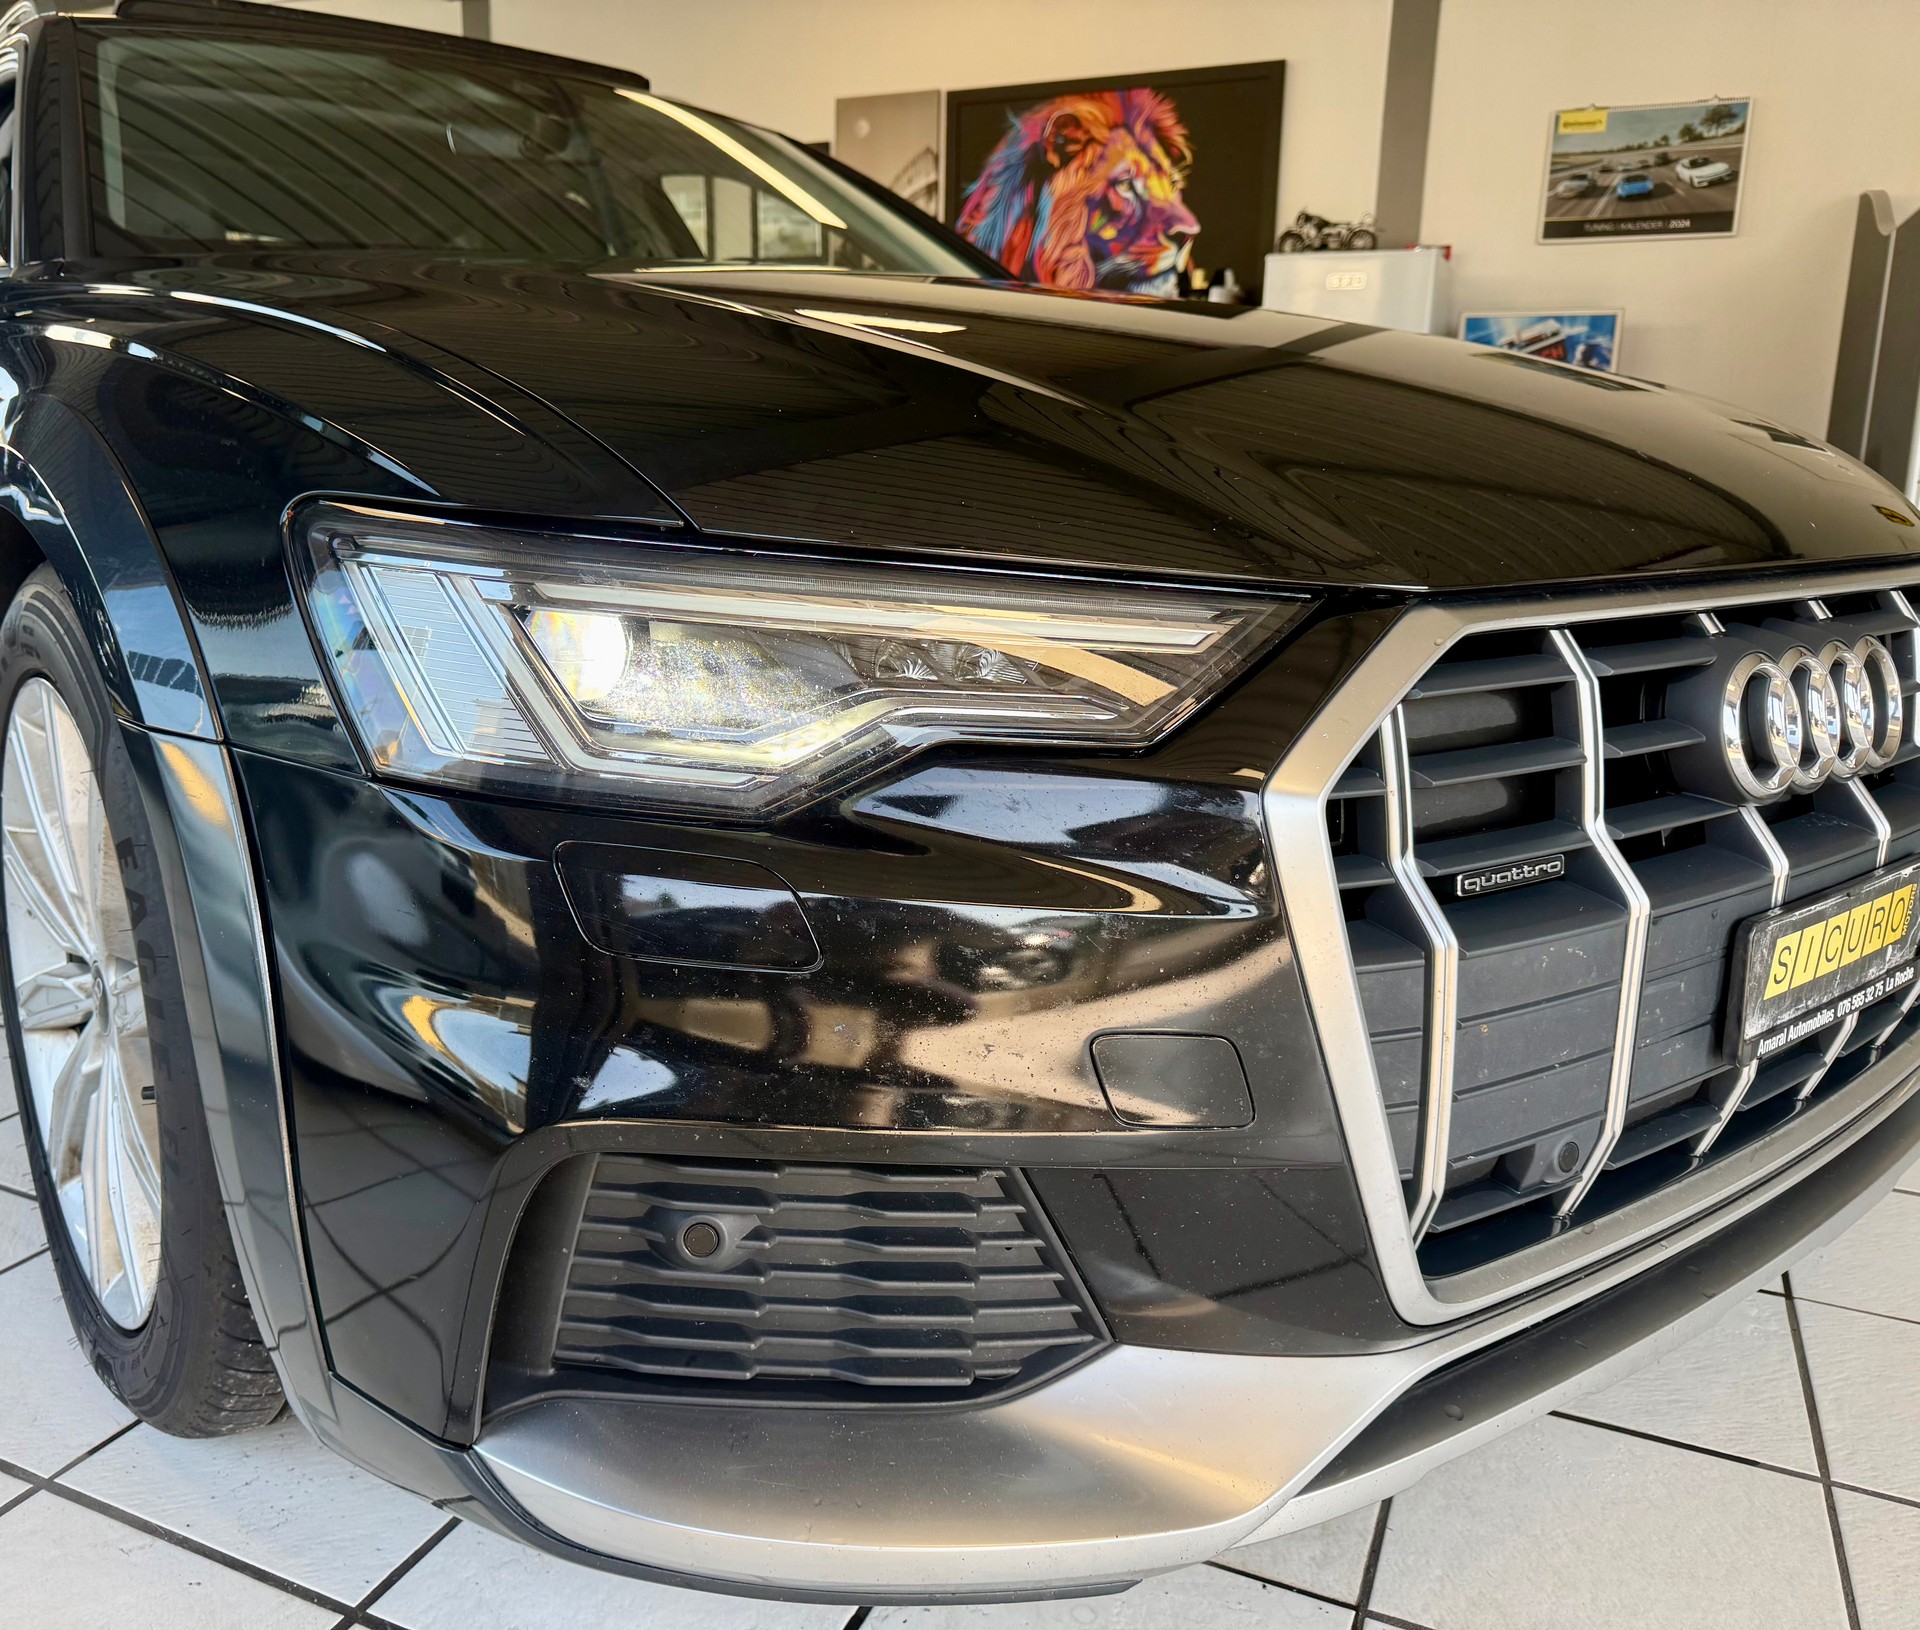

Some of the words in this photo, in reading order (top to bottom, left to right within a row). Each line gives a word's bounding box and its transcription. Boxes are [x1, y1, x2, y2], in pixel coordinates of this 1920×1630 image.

[1464, 861, 1561, 891] quattro
[1773, 897, 1906, 985] SICURO
[1757, 1029, 1787, 1056] Amaral
[1788, 1008, 1835, 1042] Automobiles
[1837, 998, 1851, 1018] 076
[1851, 990, 1865, 1010] 565
[1865, 985, 1875, 1001] 32
[1874, 982, 1884, 998] 75
[1886, 977, 1894, 990] La
[1894, 966, 1914, 987] Roche
